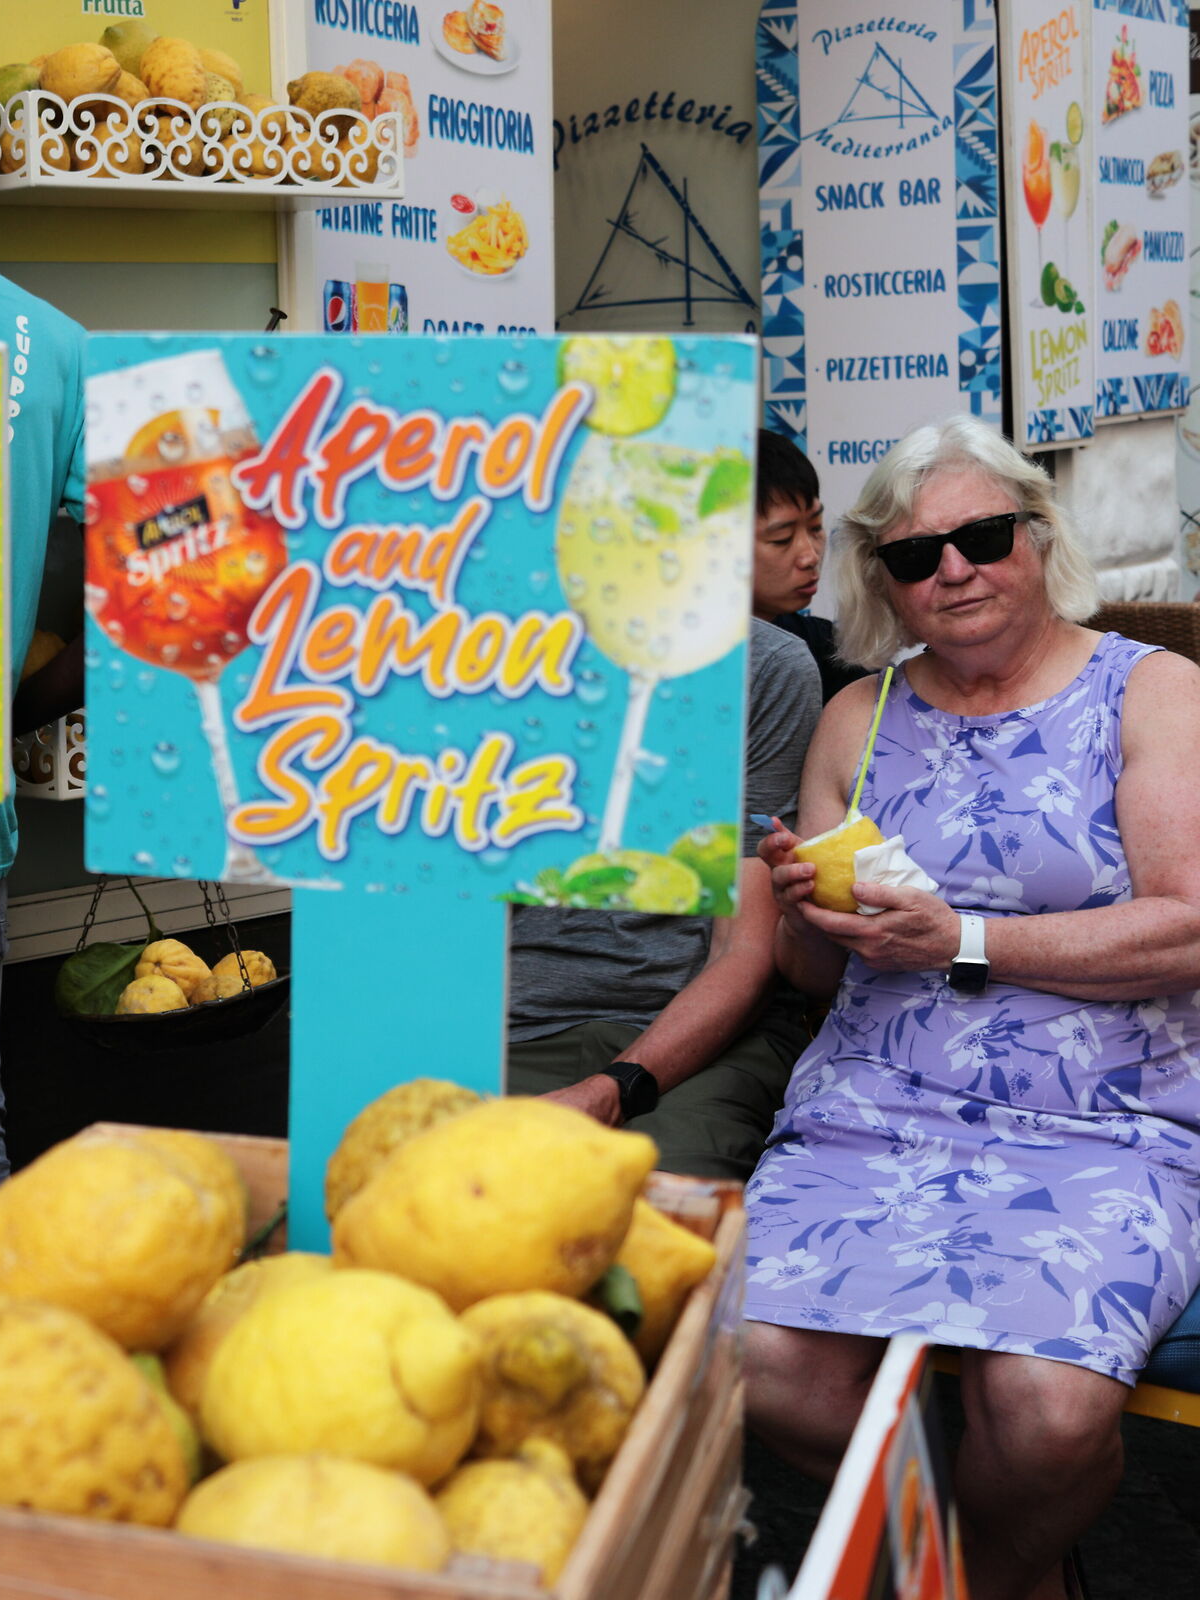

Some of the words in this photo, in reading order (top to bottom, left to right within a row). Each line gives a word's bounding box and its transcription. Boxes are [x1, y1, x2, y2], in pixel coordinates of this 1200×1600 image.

[812, 16, 938, 56] Pizzetteria
[1018, 5, 1080, 83] APEROL
[1149, 69, 1175, 110] PIZZA
[428, 94, 535, 155] FRIGGITORIA
[813, 115, 954, 159] Mediterranea
[815, 180, 886, 212] SNACK
[898, 177, 942, 207] BAR
[315, 202, 384, 238] ATATINE
[392, 203, 437, 244] FRITTE
[824, 269, 946, 299] ROSTICCERIA
[1102, 319, 1139, 352] CALZONE
[826, 353, 949, 382] PIZZETTERIA
[231, 367, 595, 528] Aperol
[828, 439, 901, 465] FRIGG
[323, 498, 489, 606] and
[232, 561, 591, 733] Lemon
[225, 710, 587, 860] Spritz
